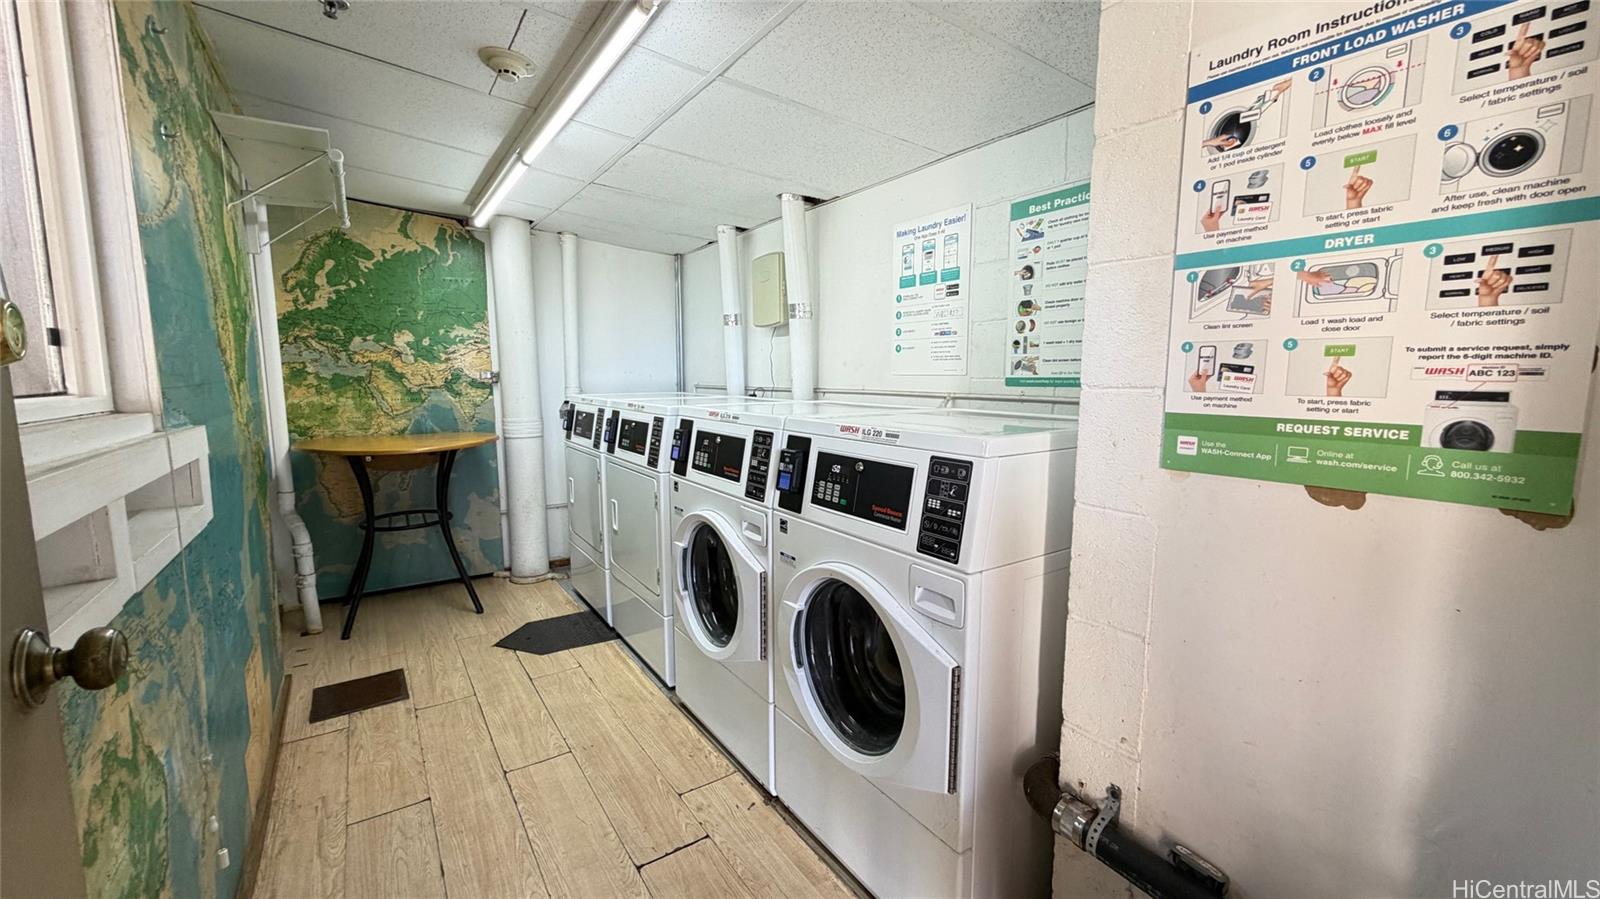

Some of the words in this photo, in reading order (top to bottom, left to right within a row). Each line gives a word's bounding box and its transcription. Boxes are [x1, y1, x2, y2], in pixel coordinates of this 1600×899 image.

[1208, 45, 1263, 71] Laundry
[1268, 29, 1312, 50] Room
[1316, 0, 1416, 34] Instruction
[1292, 44, 1341, 68] FRONT
[1344, 29, 1387, 52] LOAD
[1391, 3, 1465, 36] WASHER
[1456, 27, 1464, 35] 3
[1459, 91, 1490, 104] Select
[1493, 74, 1558, 95] temperature
[1568, 66, 1588, 78] soil
[1488, 95, 1516, 107] fabric
[1519, 83, 1562, 99] settings
[1314, 129, 1333, 138] Load
[1334, 123, 1362, 134] clothes
[1364, 115, 1394, 127] loosely
[1395, 109, 1413, 119] and
[1312, 137, 1336, 147] evenly
[1337, 131, 1360, 141] below
[1362, 125, 1383, 136] MAX
[1396, 117, 1417, 127] level
[1208, 156, 1220, 164] Add
[1232, 152, 1244, 160] cup
[1254, 141, 1286, 154] detergent
[1223, 160, 1236, 169] pod
[1237, 155, 1256, 165] inside
[1256, 149, 1283, 161] cylinder
[1350, 155, 1370, 163] START
[1443, 192, 1466, 203] After
[1469, 190, 1489, 199] use,
[1492, 185, 1521, 195] clean
[1523, 177, 1571, 191] machine
[1431, 205, 1449, 214] and
[1451, 200, 1475, 211] keep
[1477, 198, 1502, 208] fresh
[1505, 195, 1527, 204] with
[1528, 190, 1554, 200] door
[1557, 185, 1587, 196] open
[1029, 201, 1051, 214] Best
[1326, 212, 1345, 221] start,
[1346, 210, 1369, 219] press
[1371, 205, 1393, 215] fabric
[896, 228, 916, 238] Making
[918, 221, 942, 233] Laundry
[944, 213, 967, 226] Easier!
[1325, 221, 1350, 229] setting
[1362, 215, 1381, 223] start
[1216, 229, 1242, 238] payment
[1244, 224, 1268, 234] method
[1226, 235, 1252, 243] machine
[1324, 233, 1375, 249] DRYER
[1461, 309, 1521, 319] temperature
[1457, 319, 1483, 327] fabric
[1486, 317, 1526, 326] settings
[1492, 344, 1532, 353] request,
[1535, 343, 1570, 351] simply
[1463, 353, 1492, 361] 6-digit
[1424, 367, 1465, 376] WASH
[1497, 369, 1516, 377] 123
[840, 425, 860, 434] WASH
[1276, 423, 1340, 436] REQUEST
[1343, 427, 1410, 440] SERVICE
[1201, 447, 1254, 459] WASH-Connect
[1256, 453, 1272, 461] App
[1317, 449, 1343, 459] Online
[1316, 459, 1398, 472] wash.com/service
[1452, 460, 1472, 469] Call
[1450, 471, 1526, 485] 800.342-5932
